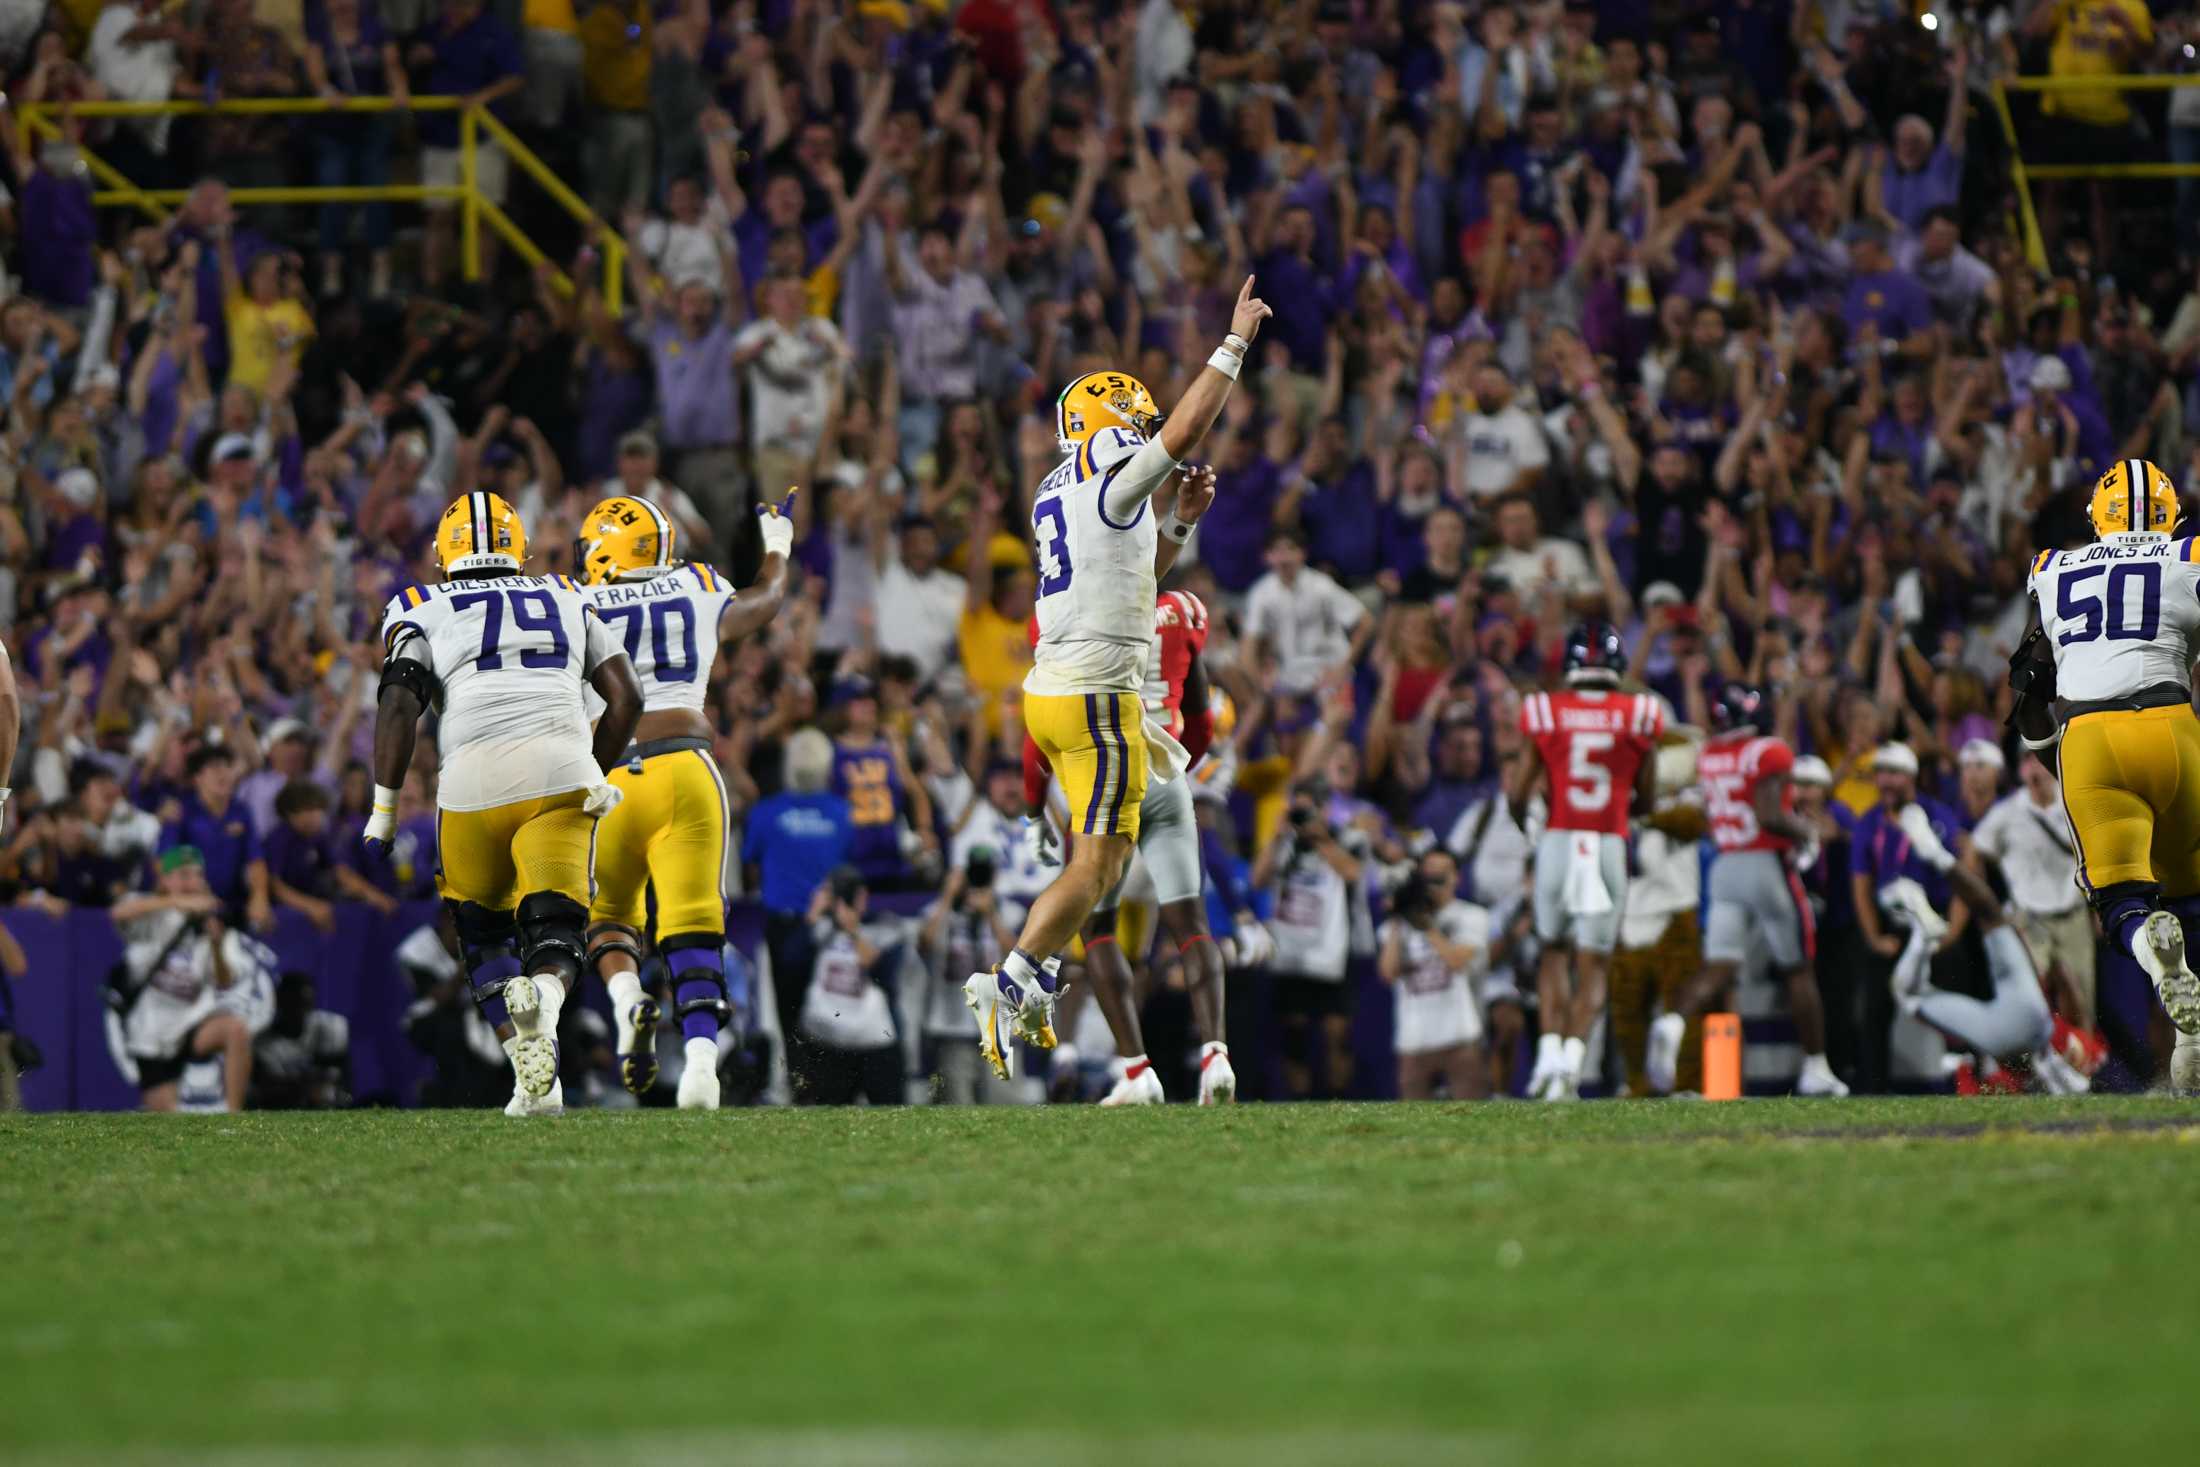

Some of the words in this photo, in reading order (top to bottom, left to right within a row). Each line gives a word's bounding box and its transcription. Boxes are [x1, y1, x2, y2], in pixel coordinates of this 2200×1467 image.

[1086, 376, 1144, 397] LSU
[2117, 535, 2162, 543] TIGERS
[463, 557, 508, 567] TIGERS
[2059, 552, 2074, 567] E.
[2079, 546, 2137, 563] JONES
[2142, 544, 2170, 558] JR.
[437, 576, 531, 593] CHESTER
[593, 576, 683, 606] FRAZIER
[2057, 562, 2162, 647] 50
[451, 588, 569, 671] 79
[598, 597, 698, 683] 70
[1567, 732, 1615, 811] 5
